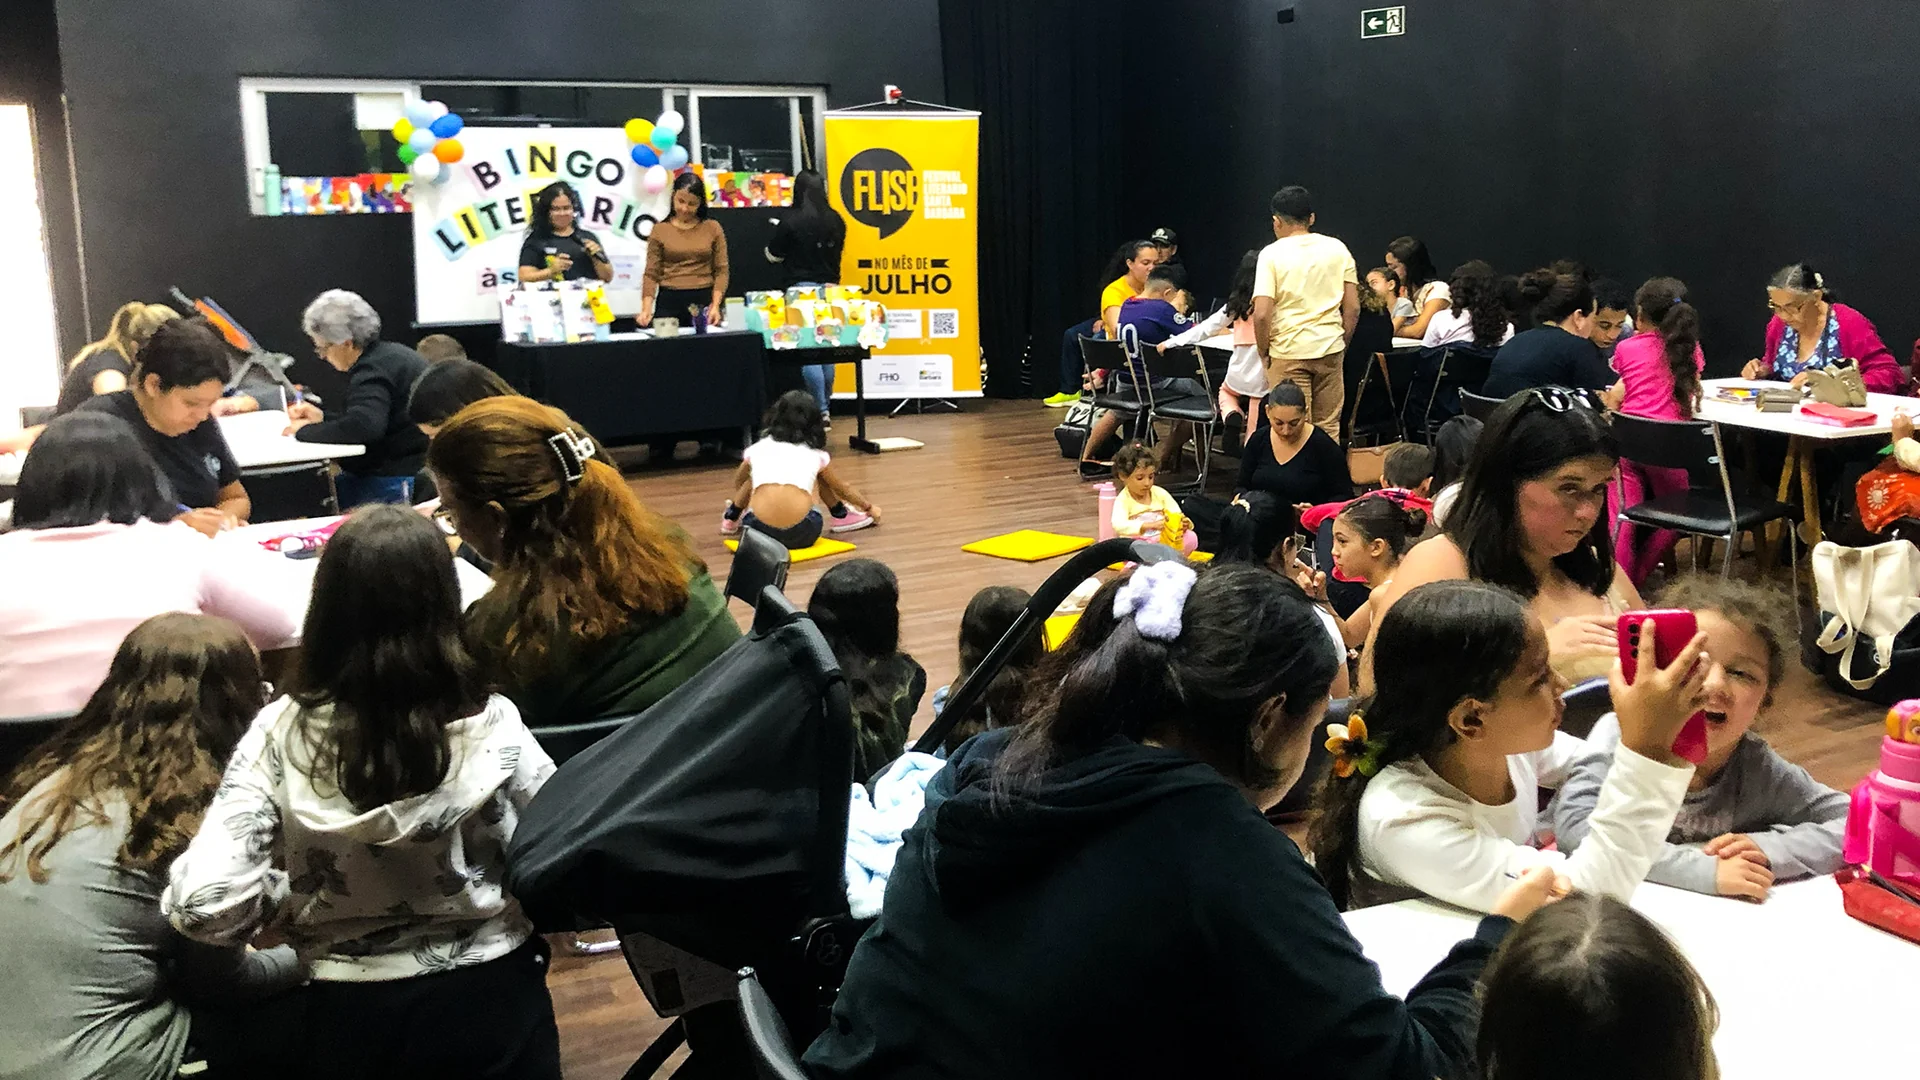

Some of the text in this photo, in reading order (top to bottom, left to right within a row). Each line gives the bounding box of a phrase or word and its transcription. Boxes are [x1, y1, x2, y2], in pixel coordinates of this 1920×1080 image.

[472, 145, 624, 190] BINGO
[436, 189, 658, 254] LITERIO
[874, 255, 928, 270] NO MÊS DE
[861, 273, 952, 294] JULHO
